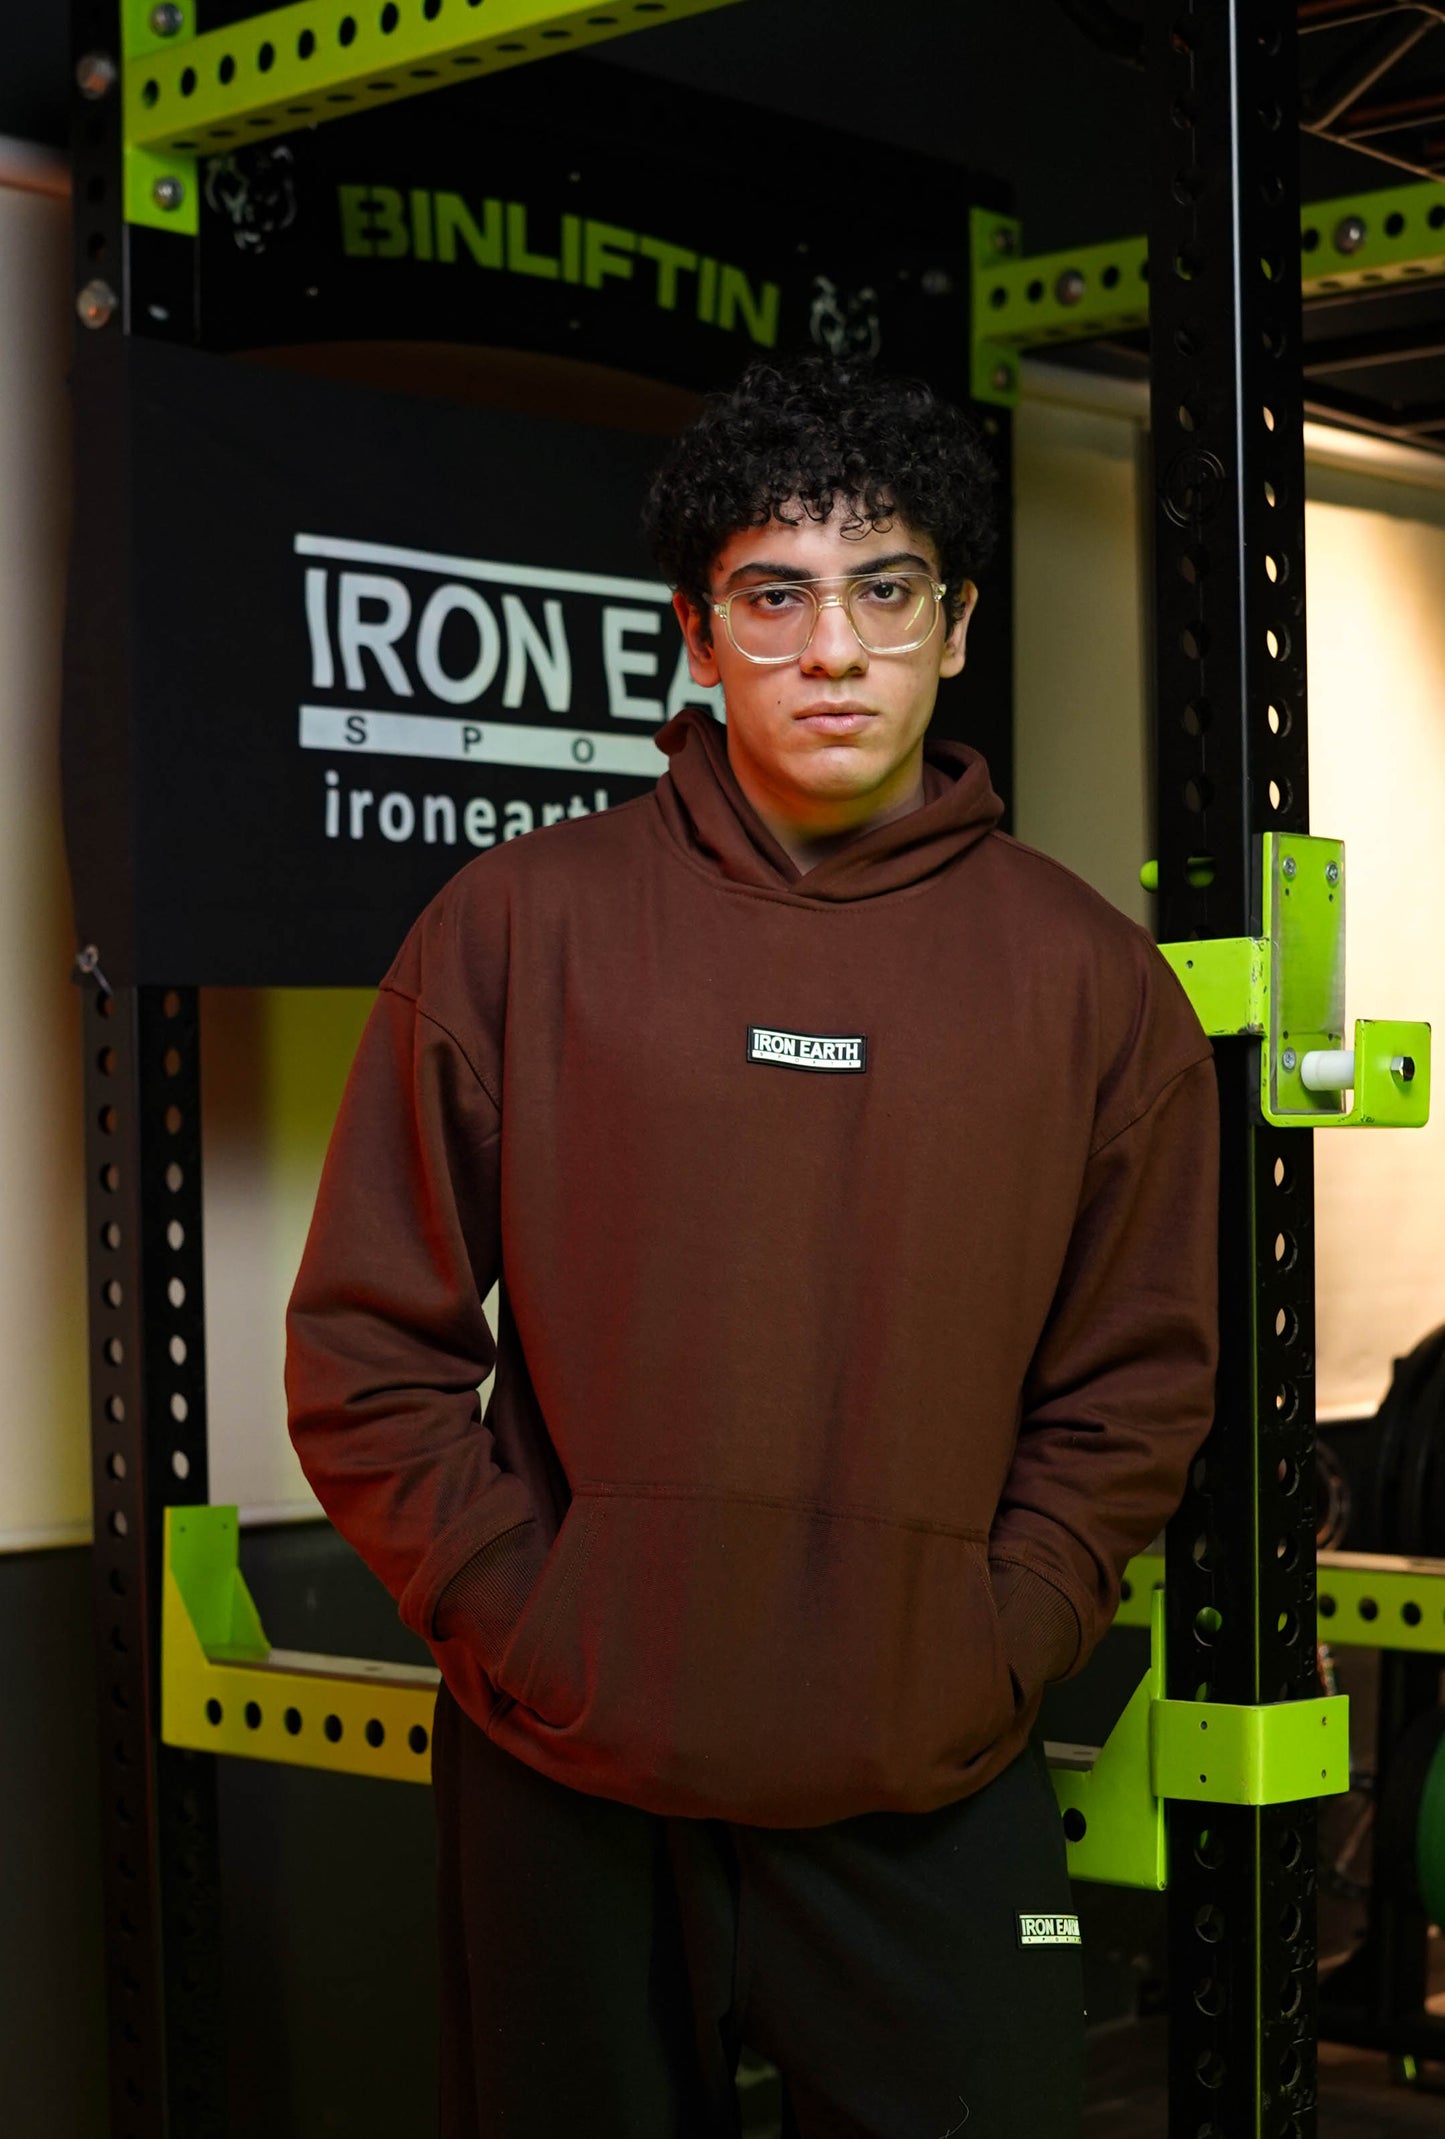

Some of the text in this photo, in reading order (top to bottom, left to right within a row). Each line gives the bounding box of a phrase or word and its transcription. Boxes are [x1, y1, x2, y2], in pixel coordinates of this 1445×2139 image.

[304, 567, 573, 713] IRON
[753, 1033, 859, 1060] IRON EARTH
[1021, 1918, 1055, 1936] IRON
